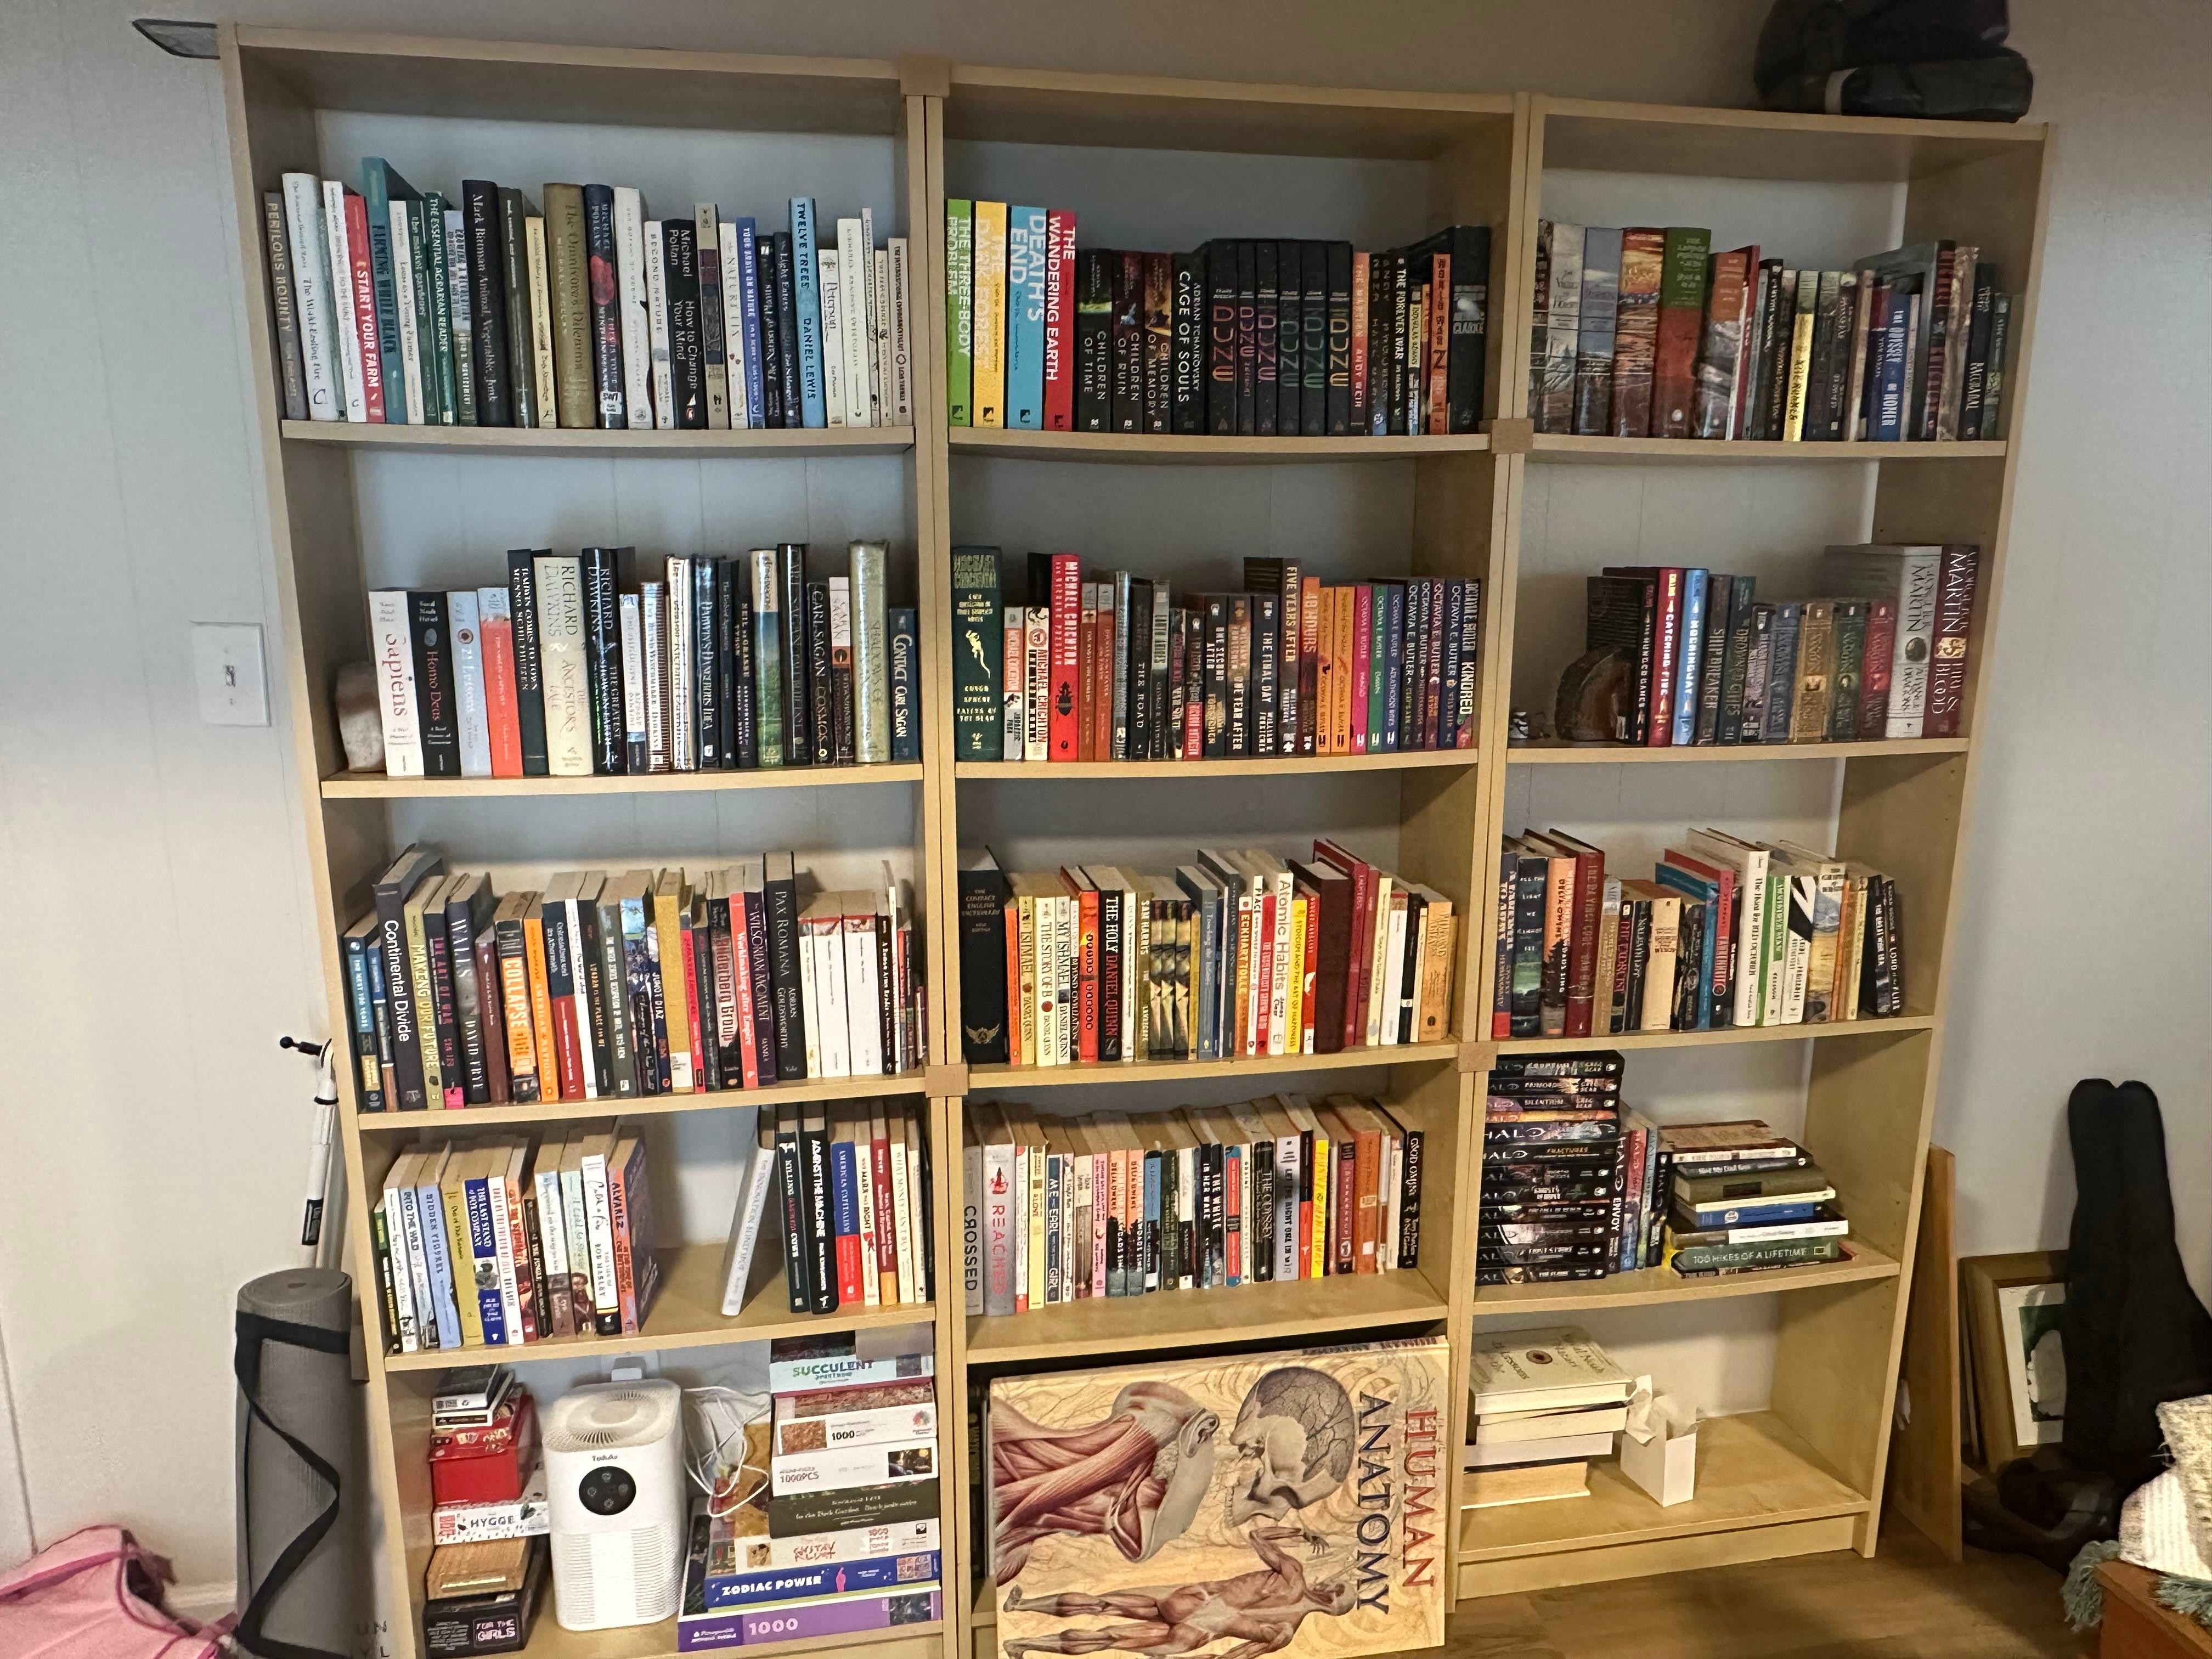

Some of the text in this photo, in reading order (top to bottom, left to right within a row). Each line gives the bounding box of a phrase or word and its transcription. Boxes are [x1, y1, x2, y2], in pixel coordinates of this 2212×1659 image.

[669, 229, 679, 266] Pollan
[681, 230, 691, 277] Michael
[798, 203, 810, 289] TWELVE TREES
[1010, 228, 1028, 285] END
[1027, 216, 1046, 321] DEATH'S
[1063, 226, 1075, 260] THE
[357, 269, 380, 387] START YOUR FARM
[1046, 216, 1060, 381] WANDERING EARTH
[1395, 269, 1406, 359] THE WAR
[676, 332, 685, 360] Mind
[686, 302, 698, 389] How Change
[803, 318, 816, 399] DANIEL LEWIS
[1084, 337, 1093, 356] OF
[1097, 330, 1105, 400] CHILDREN
[1118, 337, 1126, 356] OF
[1131, 332, 1139, 401] CHILDREN
[1148, 334, 1156, 352] OF
[1178, 271, 1191, 403] CAGE OF SOULS
[1212, 306, 1234, 382] DUNE
[1258, 314, 1277, 382] DUNE
[1280, 320, 1300, 387] DUNE
[1304, 316, 1325, 388] DUNE
[1329, 318, 1349, 387] DUNE
[1432, 349, 1446, 369] Z
[1159, 342, 1170, 409] CHILDREN
[544, 565, 561, 637] DAWKINS
[561, 566, 578, 636] RICHARD
[1286, 567, 1297, 590] FIVE
[1451, 585, 1462, 628] OCTAVIA
[1942, 553, 1967, 632] MARTIN
[1064, 561, 1078, 665] MICHAEL CRICHTON
[1285, 630, 1296, 662] AFTER
[1663, 613, 1674, 668] CATCHING
[382, 633, 407, 716] Sapiens
[427, 651, 438, 690] Homo
[893, 634, 912, 681] CONTACT
[1262, 633, 1273, 703] THE DAY
[1459, 662, 1475, 715] KINDRED
[1685, 620, 1700, 695] MOCKINGJAY
[1932, 663, 1951, 714] BLOOD
[1037, 649, 1048, 743] MICHAEL CRICHTON
[1136, 662, 1146, 729] THE ROAD
[1232, 722, 1243, 750] AFTER
[451, 918, 470, 978] WALLS
[775, 891, 791, 977] PAX ROMANA
[1021, 931, 1032, 977] ISHMAEL
[1041, 922, 1052, 943] THE
[1057, 921, 1069, 989] MY ISHMAEL
[1106, 896, 1119, 953] THE HOLY
[1240, 914, 1250, 961] ECKHART
[1274, 879, 1291, 990] Atomic Habits
[383, 921, 411, 1042] Continental Divide
[749, 909, 770, 1022] WILSONIAN MOMENT
[1041, 944, 1052, 974] STORY
[1042, 975, 1051, 989] OF
[412, 945, 438, 1070] MAKING OUR FUTURE
[504, 958, 528, 1029] COLLAPSE
[721, 1005, 735, 1043] Group
[1105, 955, 1118, 1037] DANIEL QUINN
[403, 1192, 414, 1211] INTO
[612, 1182, 624, 1231] ALVAREZ
[1213, 1172, 1221, 1193] THE
[1264, 1171, 1272, 1193] THE
[1610, 1137, 1627, 1232] HALO ENVOY
[964, 1205, 978, 1292] CROSSED
[991, 1205, 1007, 1296] REACHED
[1048, 1177, 1059, 1291] ME EARL GIRL
[1694, 1254, 1710, 1265] 100
[1740, 1251, 1754, 1261] OF
[1756, 1251, 1762, 1259] A
[792, 1359, 875, 1378] SUCCULENT
[831, 1430, 855, 1441] 1000
[1357, 1391, 1391, 1615] ANATOMY
[1402, 1407, 1437, 1587] HUMAN
[722, 1576, 822, 1596] ZODIAC POWER
[477, 1627, 516, 1642] GIRLS
[748, 1617, 799, 1636] 1000
